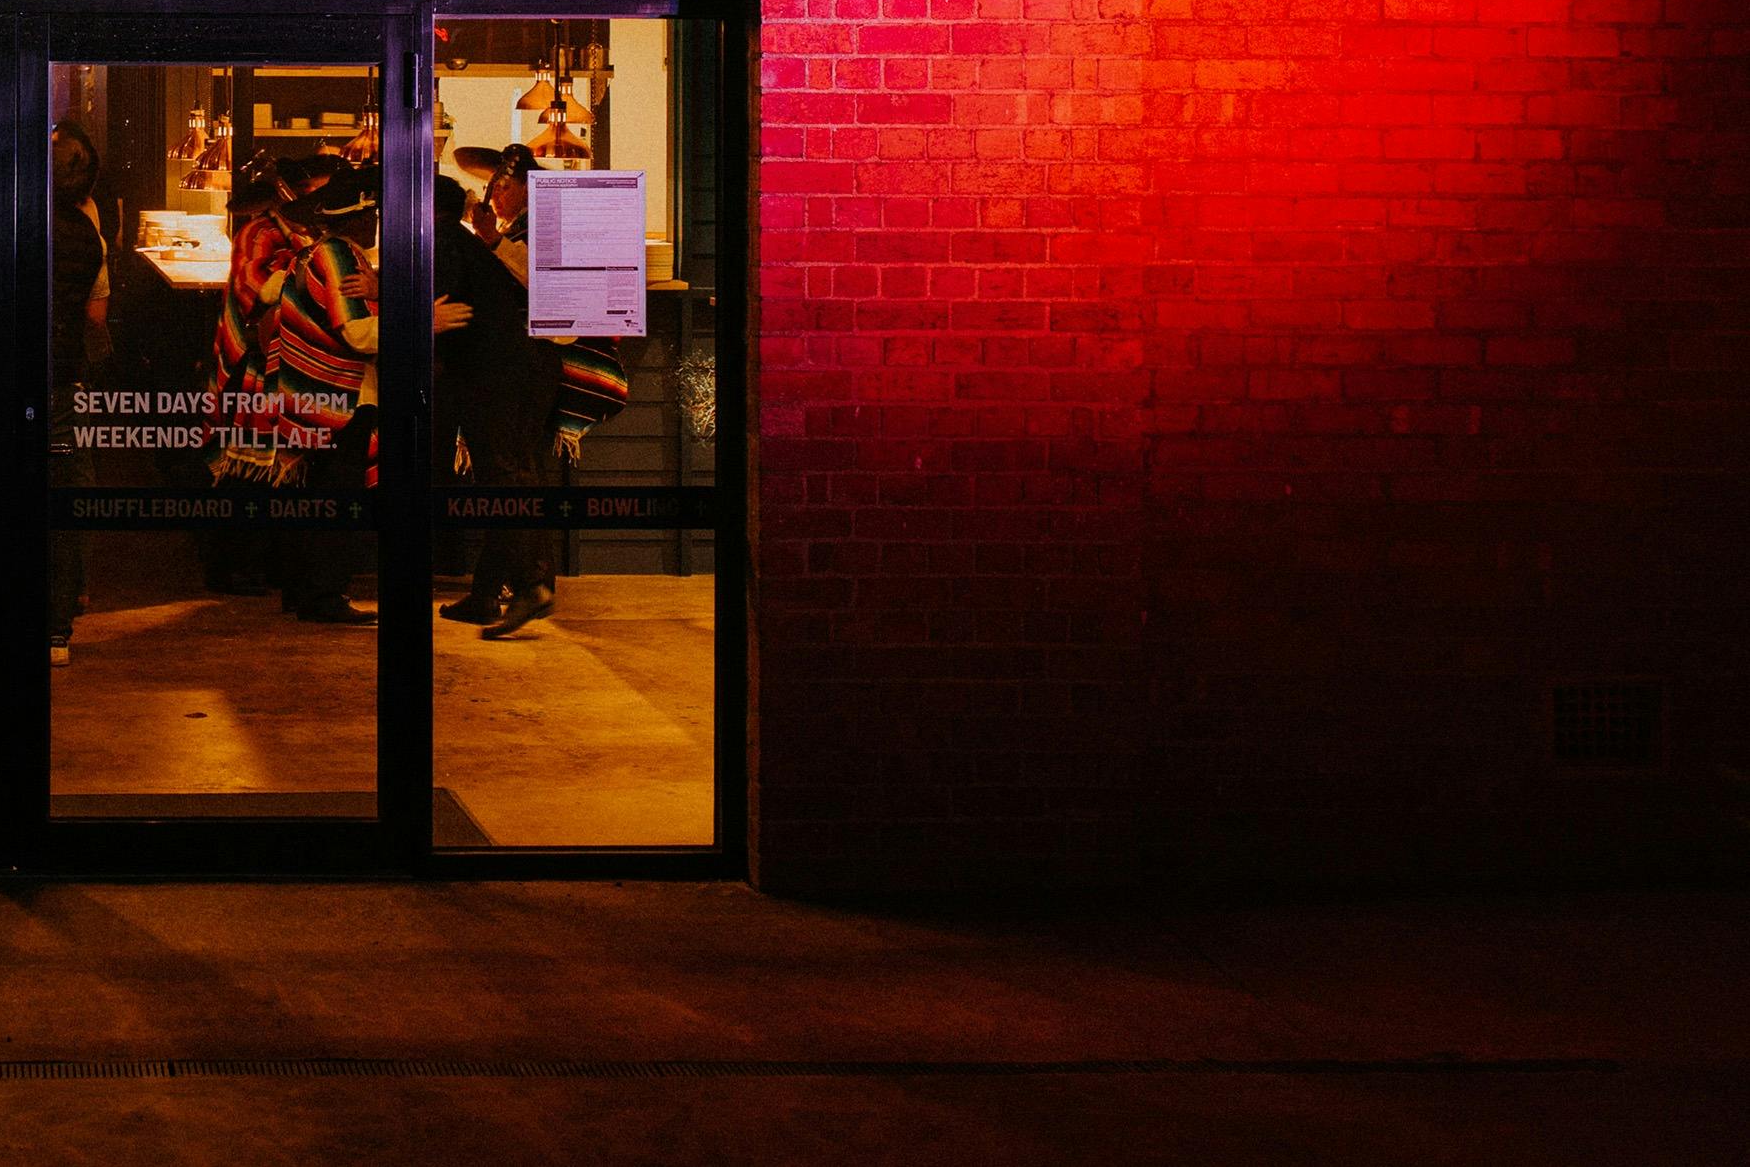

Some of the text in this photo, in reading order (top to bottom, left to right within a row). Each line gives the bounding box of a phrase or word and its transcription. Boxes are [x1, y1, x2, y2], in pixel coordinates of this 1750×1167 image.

[73, 391, 355, 414] SEVEN DAYS FROM 12PM.
[73, 426, 204, 449] WEEKENDS
[273, 426, 338, 449] LATE.
[73, 498, 339, 519] SHUFFLEBOARD DARTS
[446, 497, 546, 518] KARAOKE
